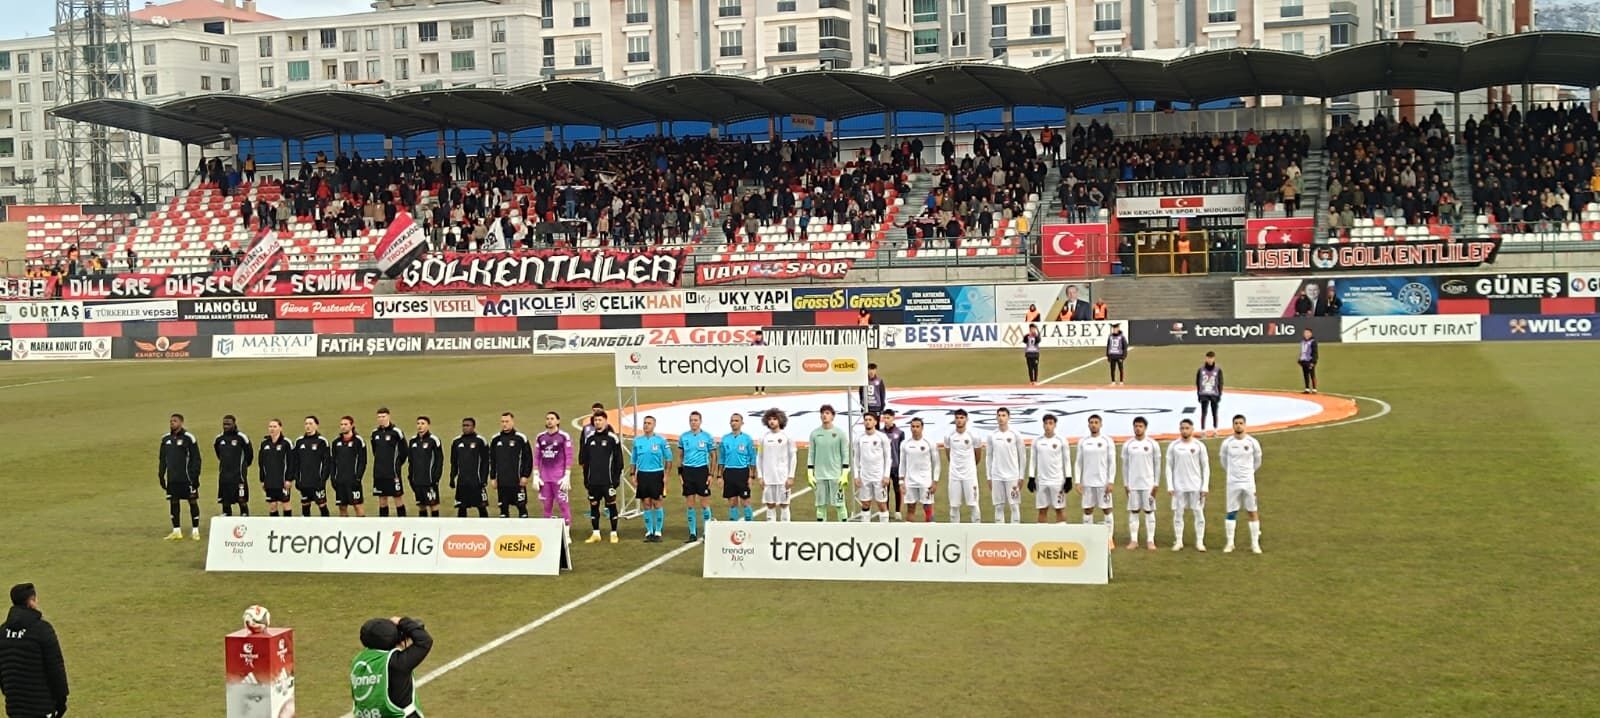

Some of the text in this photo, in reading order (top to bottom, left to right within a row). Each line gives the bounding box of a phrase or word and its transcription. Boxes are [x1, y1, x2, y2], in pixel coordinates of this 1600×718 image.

[1245, 244, 1310, 269] LİSELİ
[402, 251, 677, 288] GÖLKENTLİLER
[703, 261, 848, 281] VAN SPOR
[70, 275, 151, 297] DİLLERE
[291, 271, 377, 293] SENİNLE
[1476, 275, 1562, 298] GÜNEŞ
[719, 291, 789, 305] UKY YAPI
[19, 304, 80, 320] GÜRTAŞ
[194, 300, 257, 313] HANOĞLU
[434, 299, 475, 312] VESTEL
[482, 295, 576, 317] AÇI KOLEJİ
[1195, 324, 1263, 338] trendyol
[1369, 323, 1474, 336] TURGUT FIRAT
[1528, 319, 1592, 333] WILCO
[580, 335, 645, 347] VANGÖLÜ
[649, 329, 680, 345] 2A
[905, 325, 998, 343] BEST VAN
[30, 342, 53, 351] MARKA
[242, 335, 312, 348] MARYAP
[321, 338, 364, 353] FATİH
[425, 337, 472, 350] AZELİN
[474, 336, 531, 349] GELİNLİK
[658, 356, 748, 377] trendyol
[224, 540, 253, 549] trendyol
[268, 530, 380, 559] trendyol
[447, 541, 487, 552] trendyol
[499, 539, 536, 552] NESİNE
[721, 547, 755, 555] trendyol
[770, 536, 899, 567] trendyol
[976, 547, 1023, 560] trendyol
[1037, 546, 1079, 561] NESİNE
